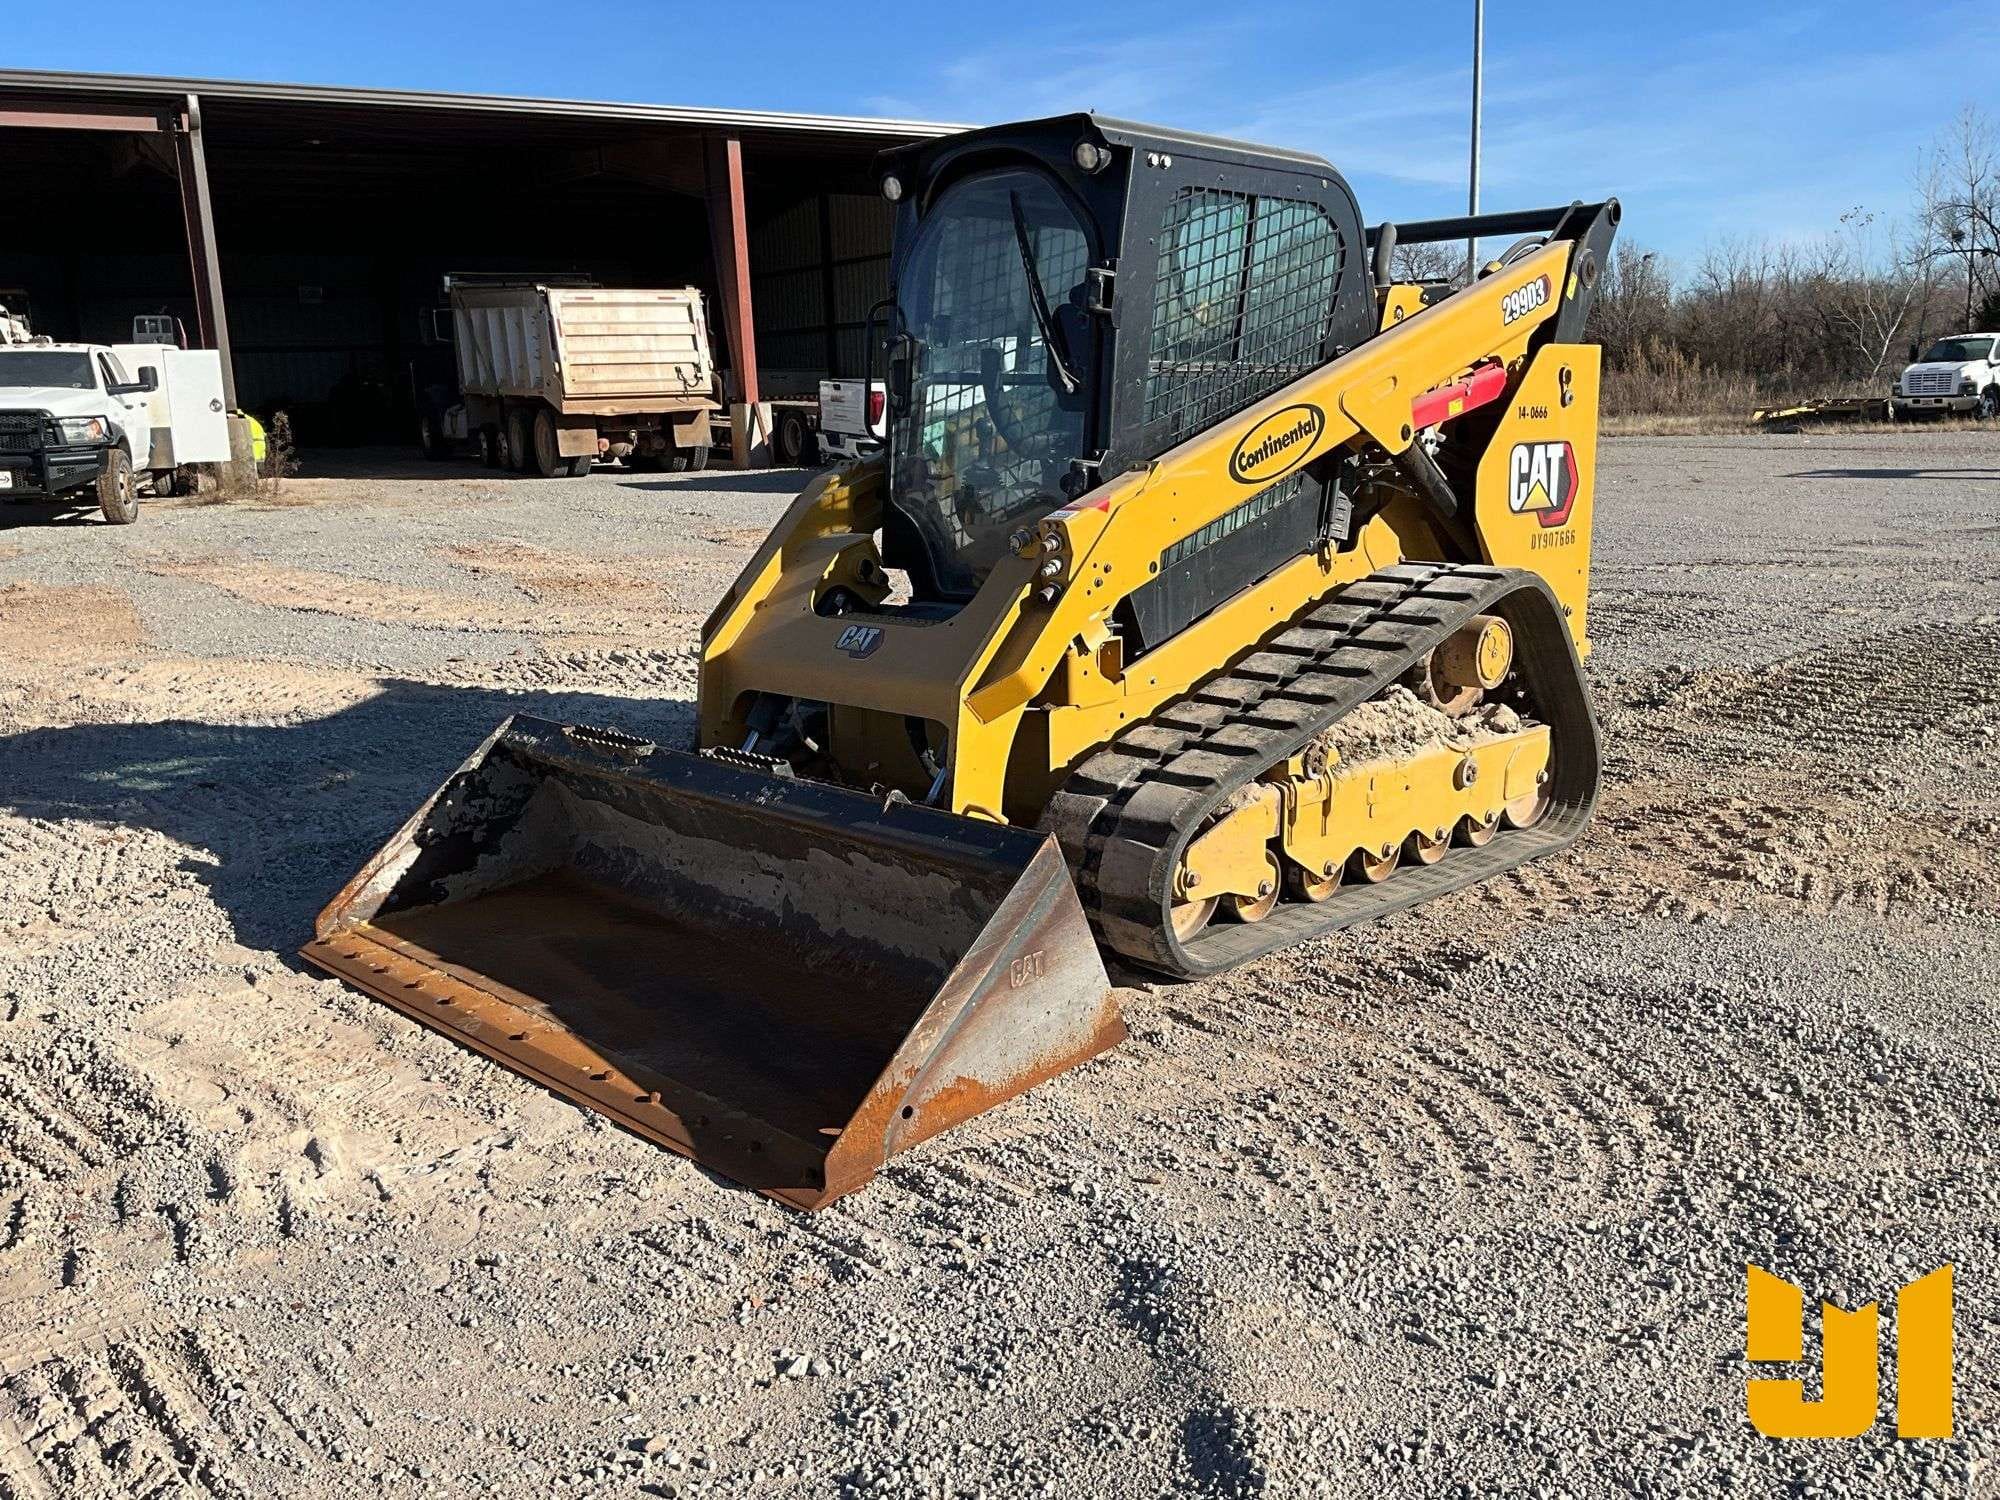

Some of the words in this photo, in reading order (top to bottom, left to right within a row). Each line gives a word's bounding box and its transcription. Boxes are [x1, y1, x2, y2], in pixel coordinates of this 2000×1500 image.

[1502, 277, 1545, 326] 299D3
[1237, 408, 1316, 472] Continental
[1509, 443, 1565, 512] CAT
[1531, 529, 1576, 550] DY907666
[836, 625, 880, 652] CAT
[1010, 950, 1046, 988] CAT
